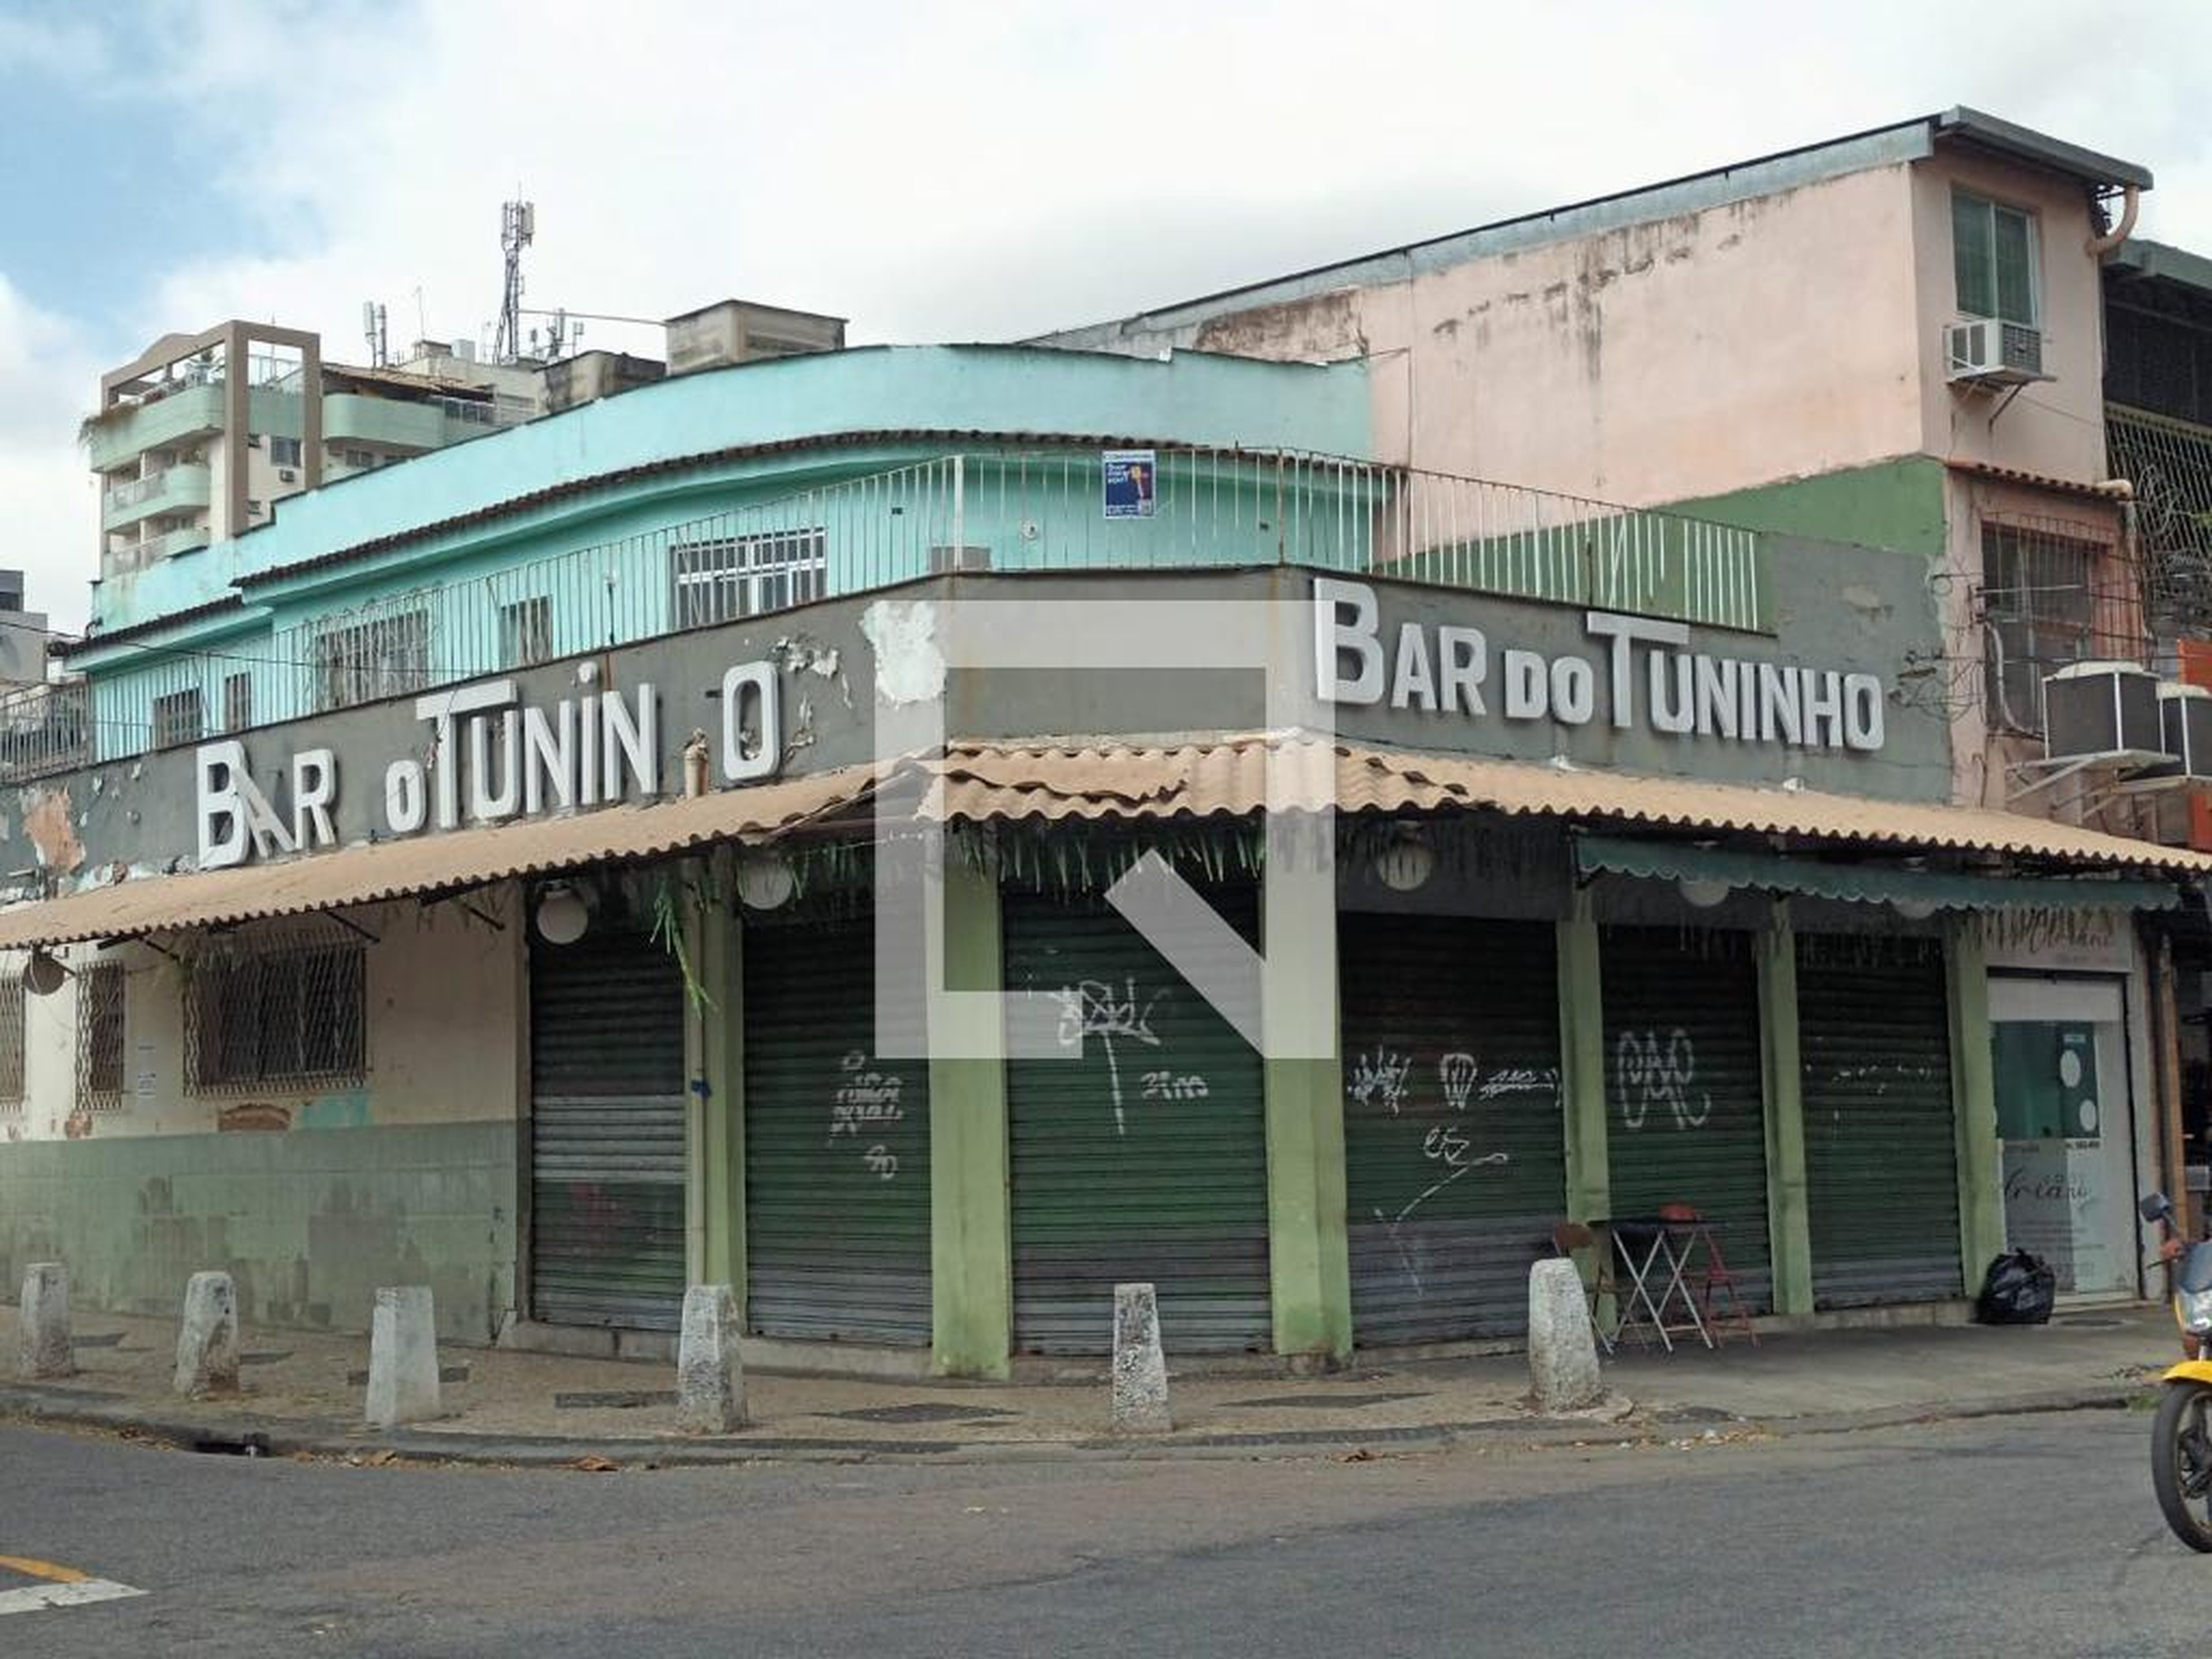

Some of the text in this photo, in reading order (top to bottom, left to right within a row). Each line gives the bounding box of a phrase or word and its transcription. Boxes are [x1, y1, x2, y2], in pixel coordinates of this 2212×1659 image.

[1314, 578, 1885, 749] BAR DO TUNINHO
[196, 740, 336, 870] BAR
